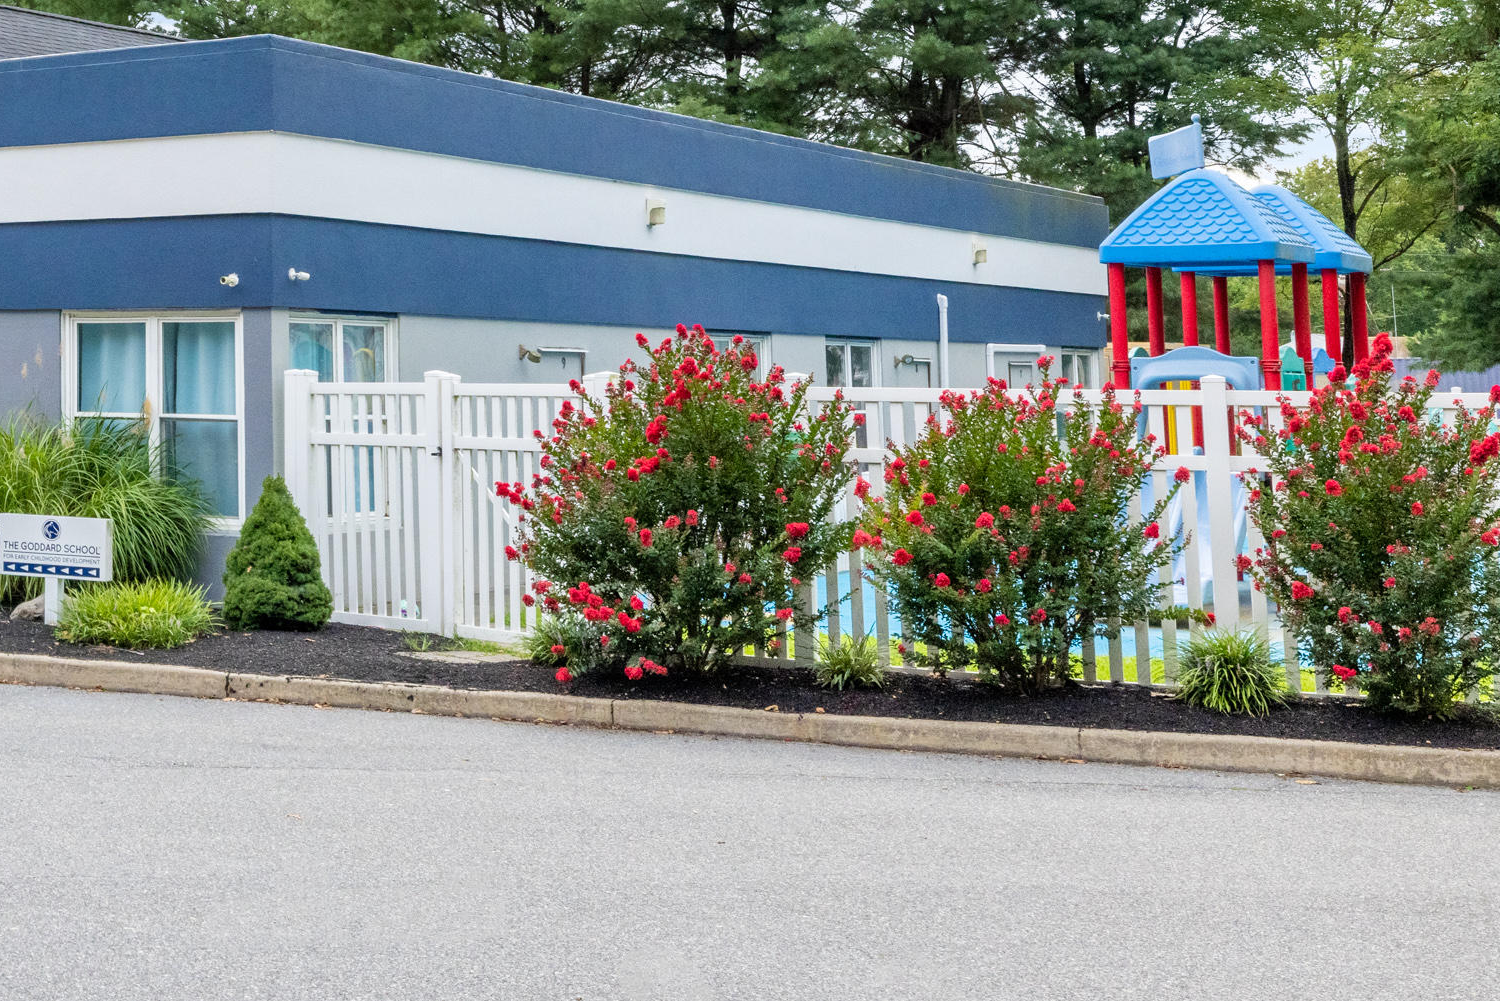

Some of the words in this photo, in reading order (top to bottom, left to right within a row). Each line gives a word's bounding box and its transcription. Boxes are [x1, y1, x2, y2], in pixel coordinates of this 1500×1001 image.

[3, 540, 19, 550] THE
[20, 541, 62, 553] GODDARD
[63, 544, 100, 555] SCHOOL
[30, 554, 61, 563] CHILDHOOD
